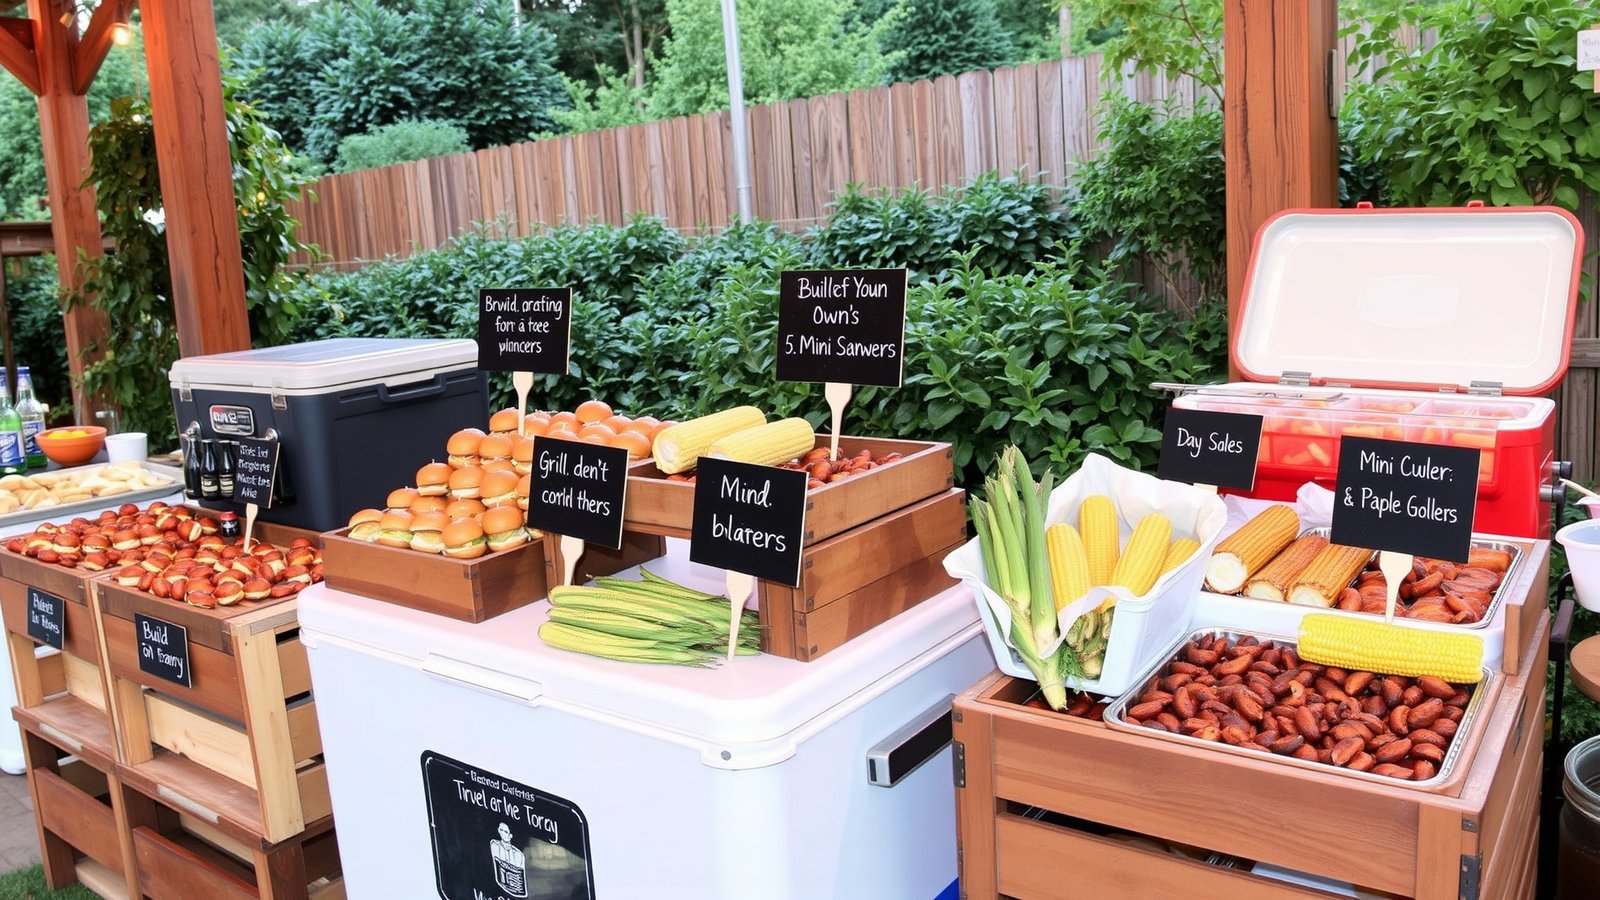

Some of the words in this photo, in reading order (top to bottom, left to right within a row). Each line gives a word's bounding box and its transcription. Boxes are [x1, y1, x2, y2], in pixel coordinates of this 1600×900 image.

[854, 276, 888, 298] Youn
[813, 304, 860, 325] Own's
[785, 334, 796, 355] 5.
[800, 335, 831, 356] Mini
[1177, 427, 1203, 459] Day
[1208, 432, 1243, 454] Sales
[574, 455, 609, 483] den't
[1360, 450, 1394, 476] Mini
[721, 474, 772, 508] Mind.
[1361, 486, 1402, 519] Paple
[1406, 496, 1458, 524] Gollers
[142, 620, 169, 646] Build
